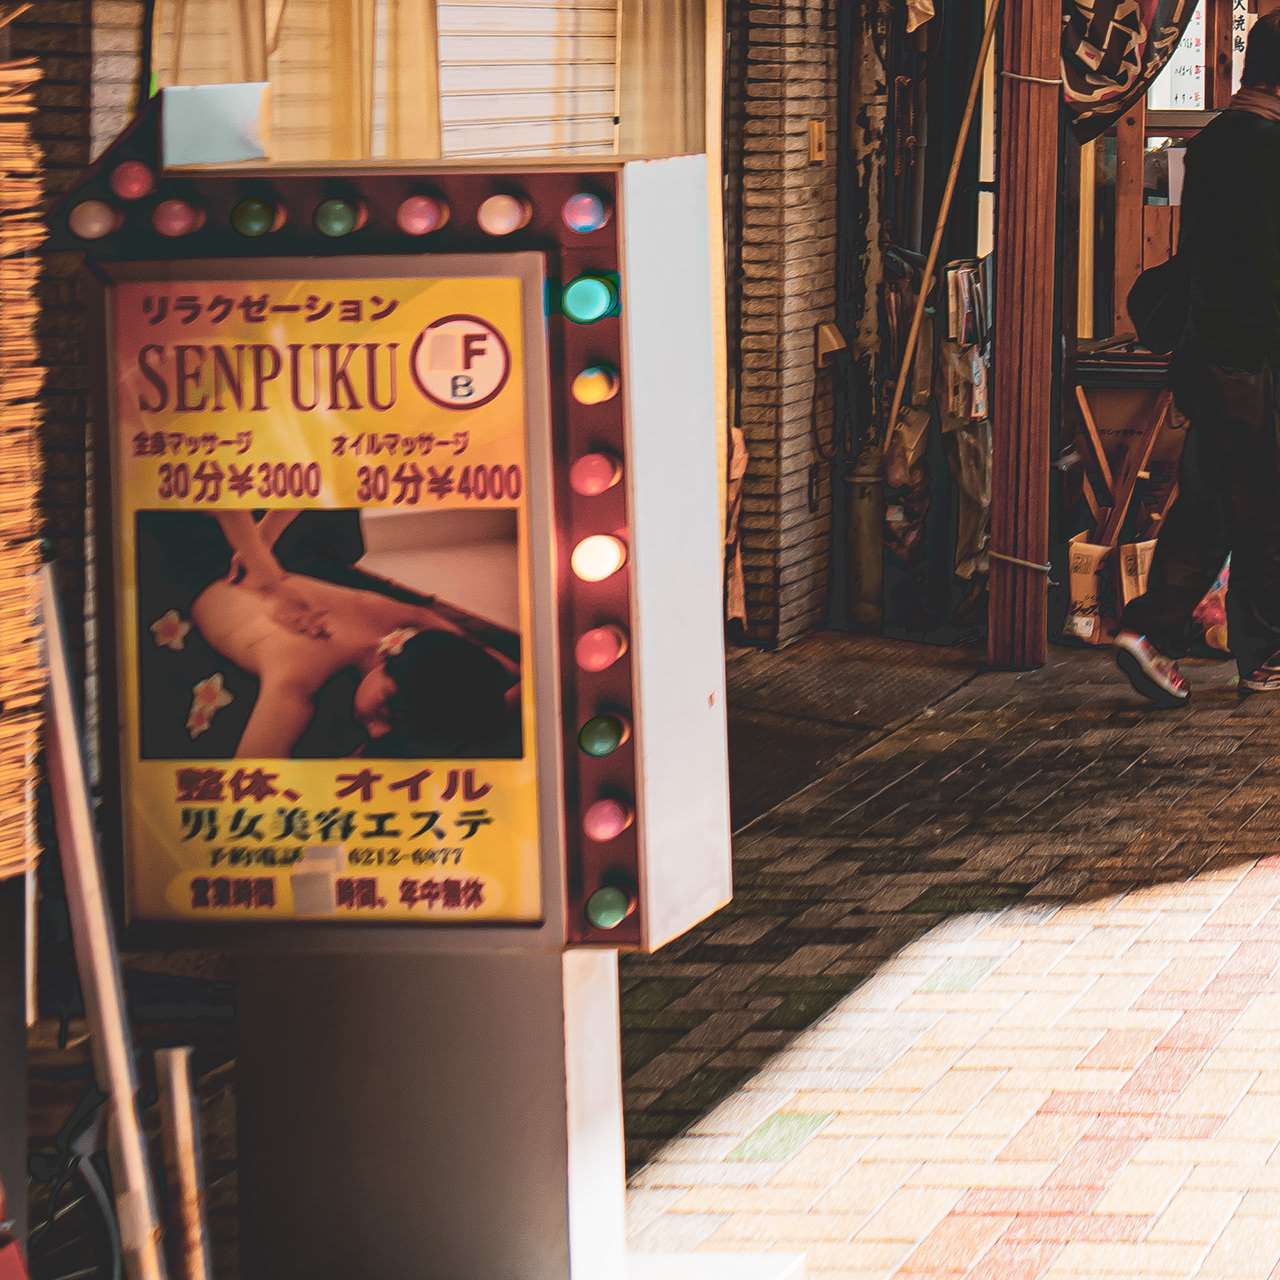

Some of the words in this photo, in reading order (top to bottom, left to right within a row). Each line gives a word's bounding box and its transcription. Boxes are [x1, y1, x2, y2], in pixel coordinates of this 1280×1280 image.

[142, 295, 400, 327] リラクゼーション
[138, 342, 400, 413] SENPUKU
[331, 430, 471, 458] オイルマッサージ
[179, 807, 494, 842] 男女美容エステ
